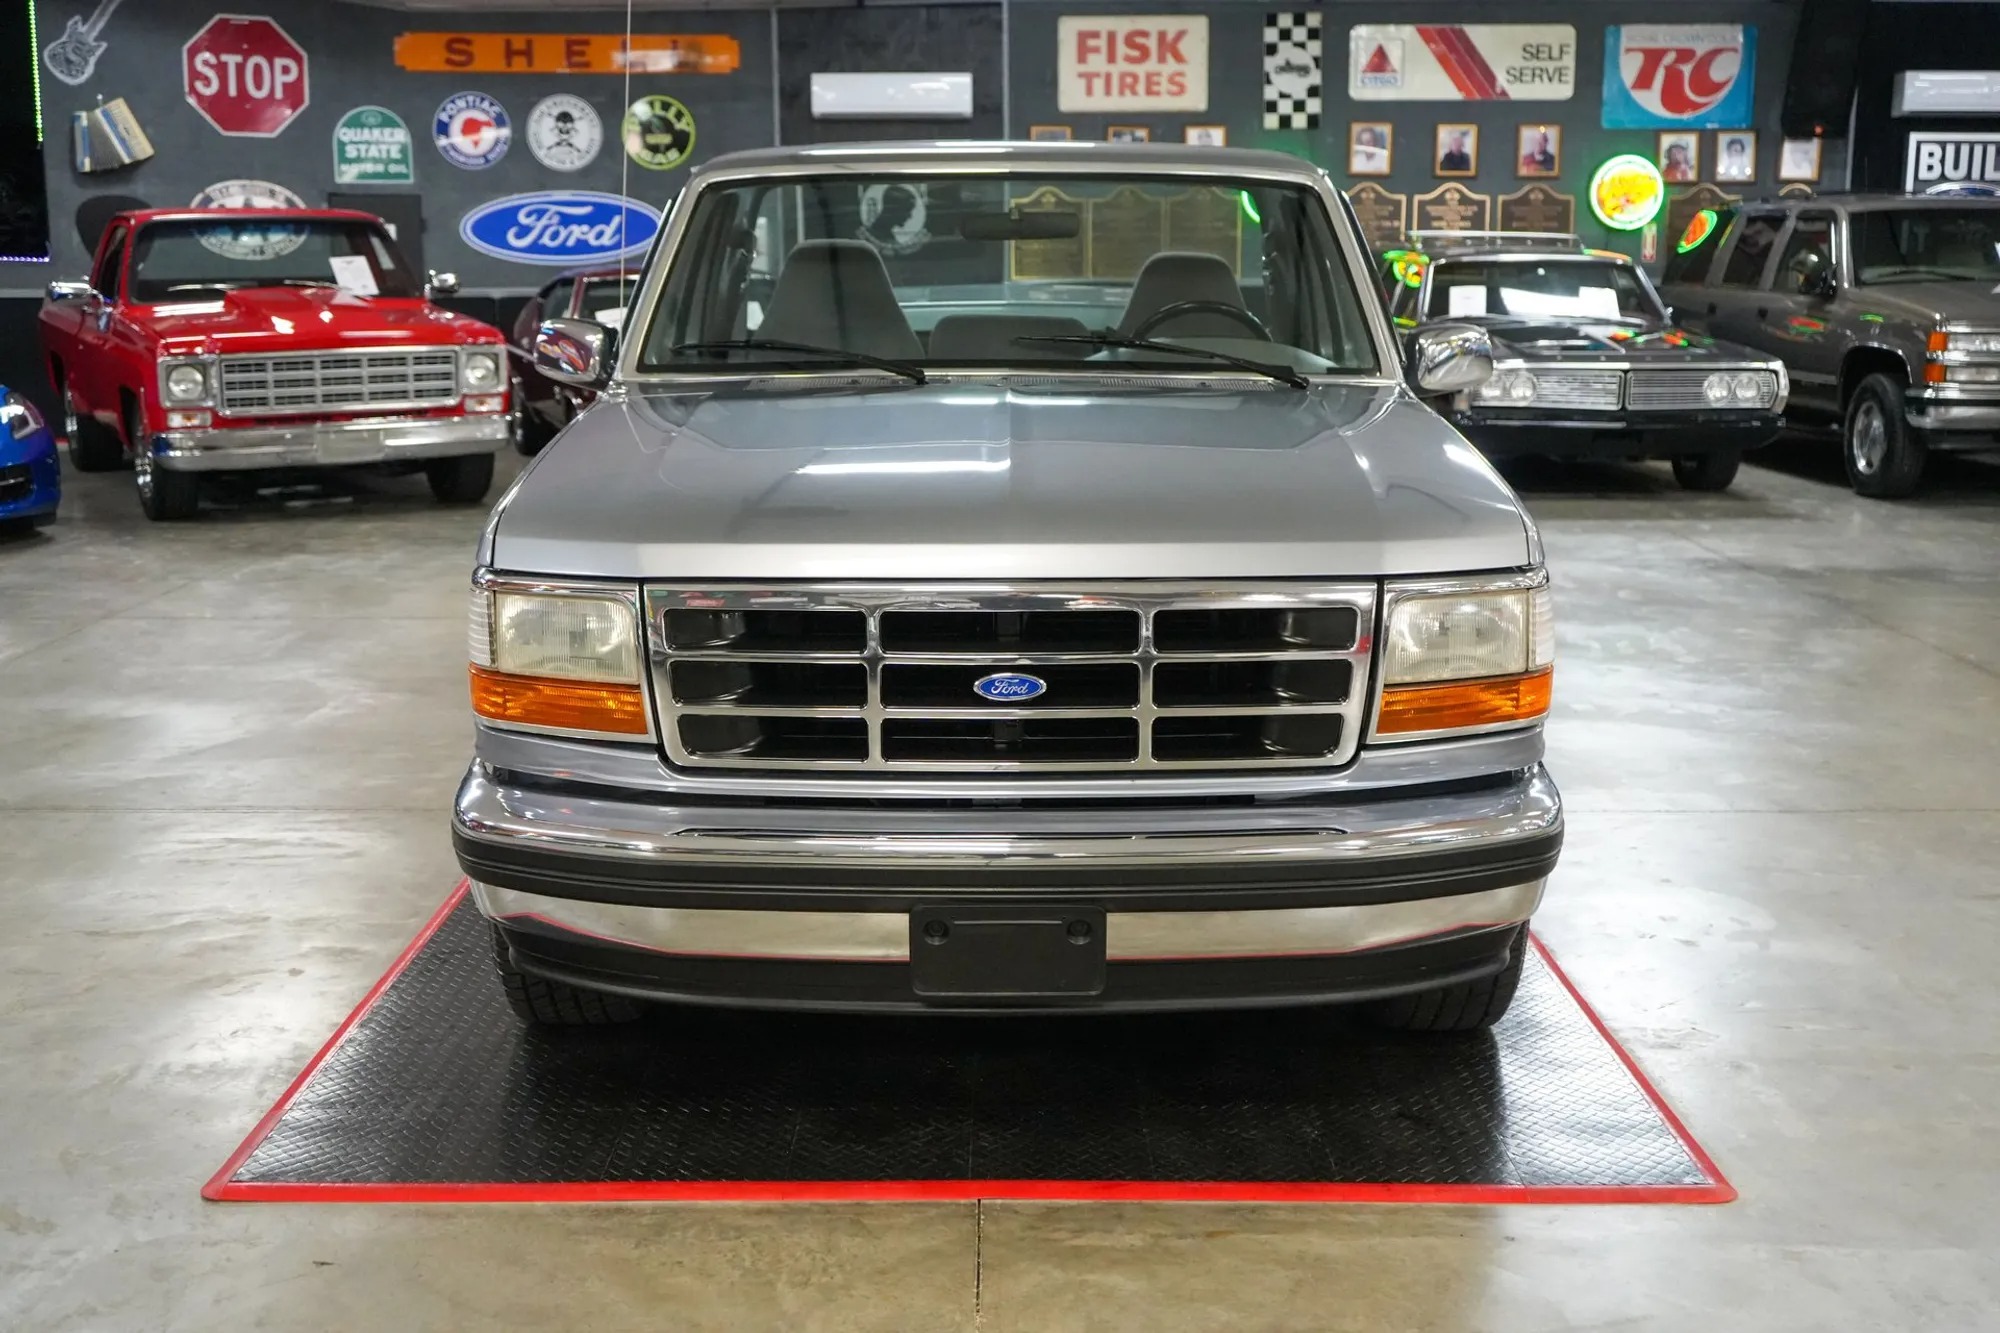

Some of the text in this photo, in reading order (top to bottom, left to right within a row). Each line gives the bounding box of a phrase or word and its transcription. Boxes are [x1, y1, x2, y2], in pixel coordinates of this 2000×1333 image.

[445, 37, 700, 69] SHEL
[1076, 29, 1189, 65] FISK
[1522, 44, 1571, 62] SELF
[194, 51, 299, 99] STOP
[1077, 71, 1187, 97] TIRES
[1506, 67, 1570, 85] SERVE
[1624, 48, 1739, 114] RC
[437, 95, 501, 123] PONTIAC
[339, 127, 406, 142] QUAKER
[345, 144, 402, 159] STATE
[506, 204, 622, 247] Ford
[991, 679, 1029, 694] Ford
